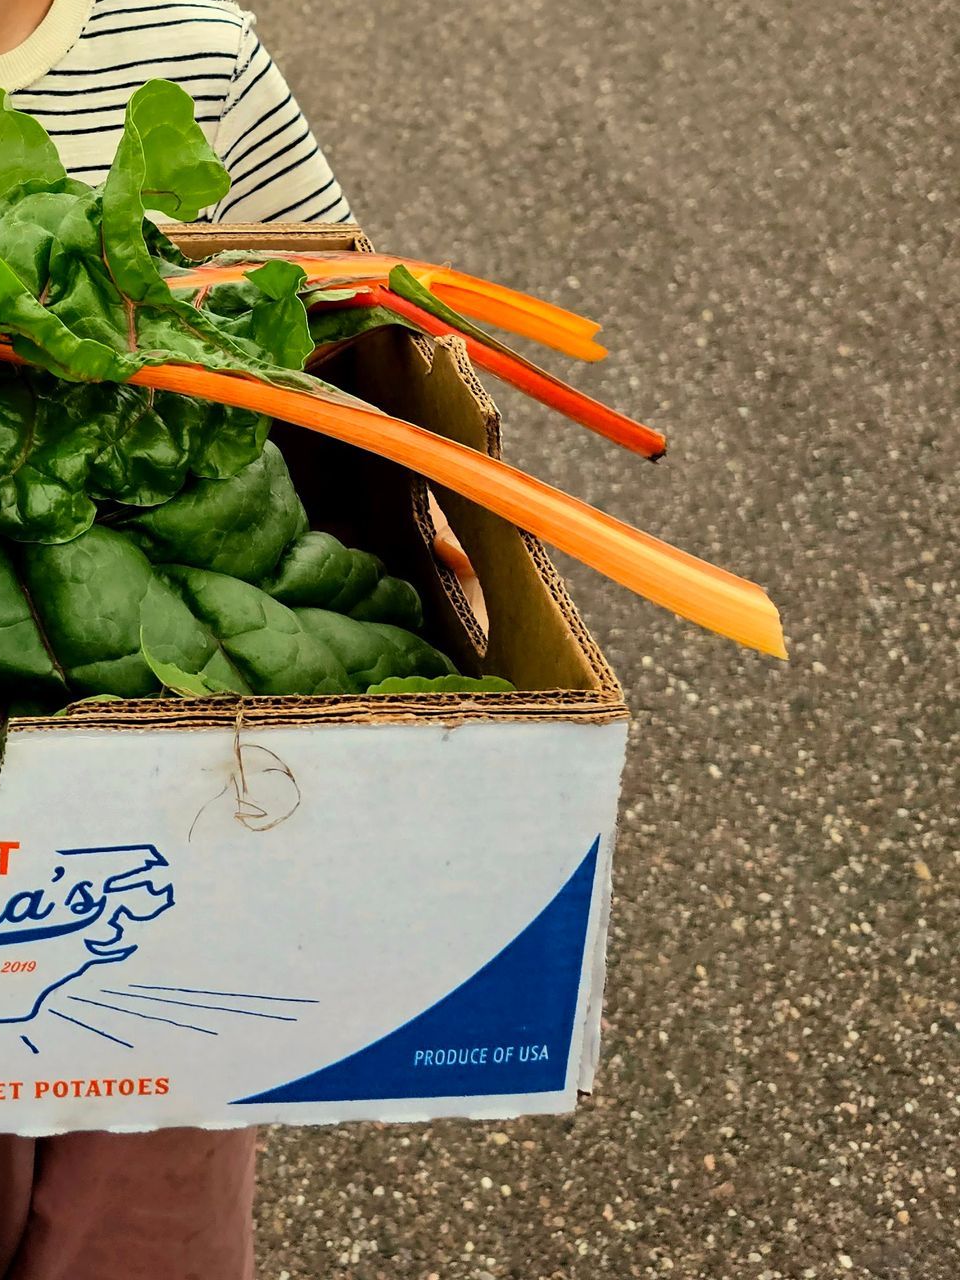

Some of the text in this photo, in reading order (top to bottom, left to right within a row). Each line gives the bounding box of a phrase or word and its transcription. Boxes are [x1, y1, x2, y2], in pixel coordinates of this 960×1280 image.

[0, 960, 37, 973] 2019
[414, 1044, 549, 1066] PRODUCE OF USA
[34, 1077, 171, 1100] POTATOES
